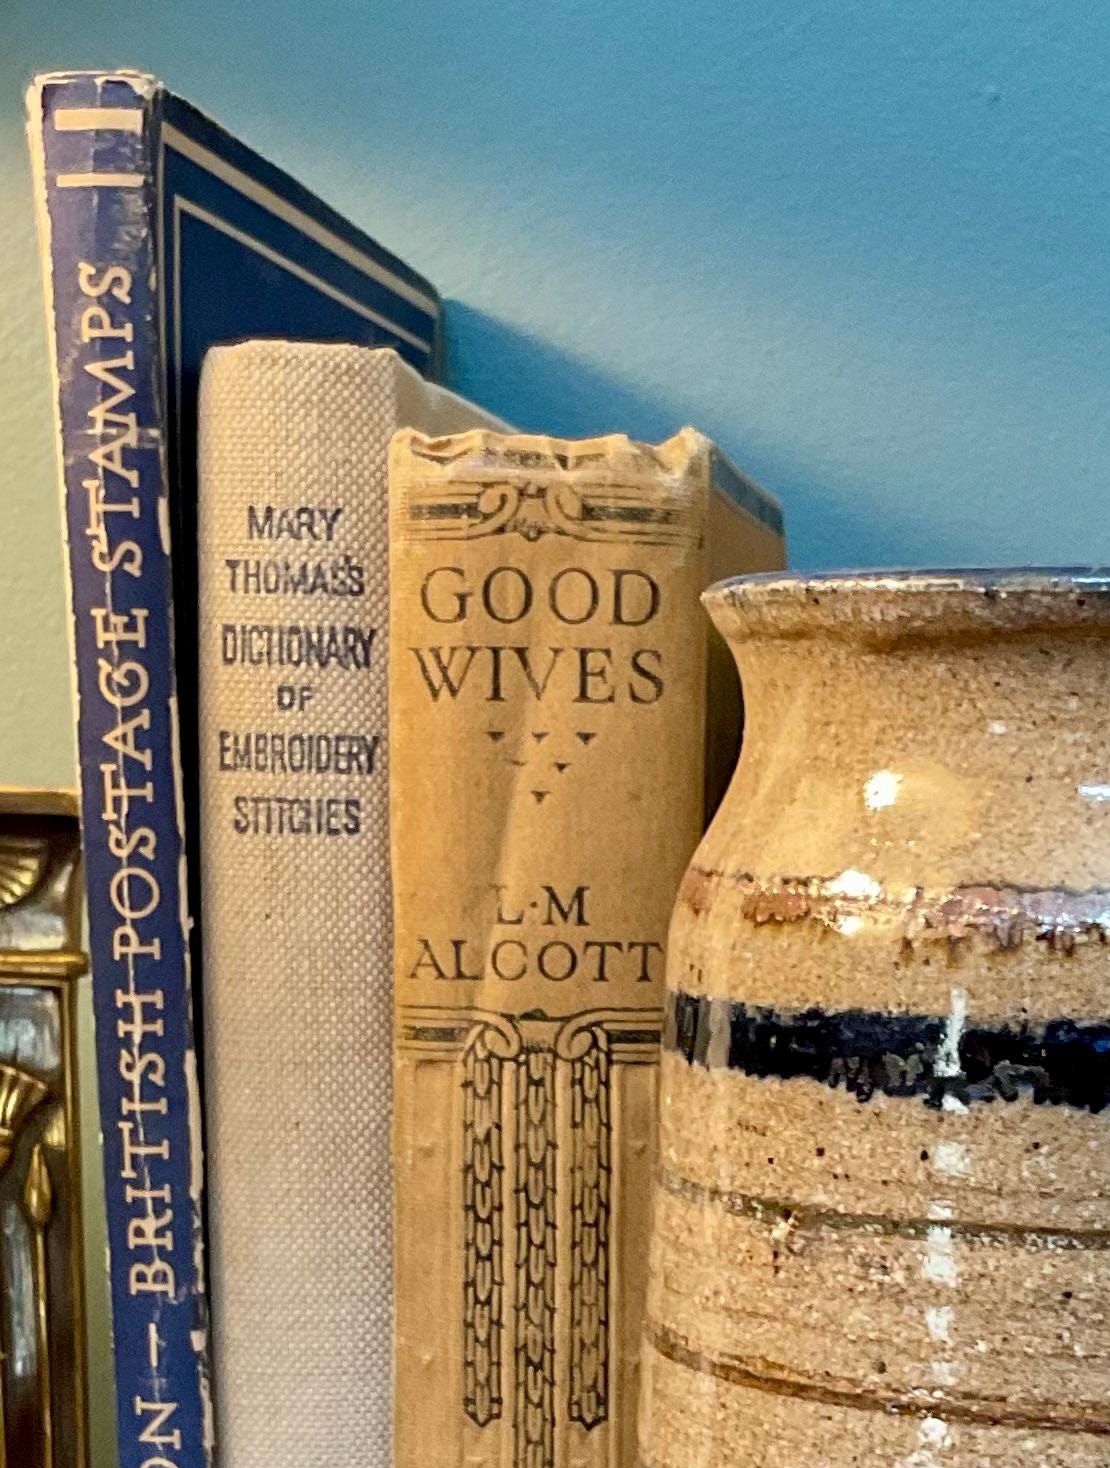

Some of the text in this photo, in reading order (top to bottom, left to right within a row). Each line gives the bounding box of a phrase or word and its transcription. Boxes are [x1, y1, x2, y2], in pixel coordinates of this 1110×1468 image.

[78, 261, 143, 578] STAMPS
[246, 505, 343, 541] MARY
[420, 566, 661, 627] GOOD
[221, 624, 377, 670] DICTIONARY
[408, 645, 665, 705] WIVES
[276, 685, 315, 712] OF
[218, 730, 380, 775] EMBROIDERY
[91, 608, 162, 961] POSTAGE
[232, 795, 362, 836] STITCHES
[406, 938, 665, 982] ALCOTT
[115, 989, 175, 1298] BRITISH
